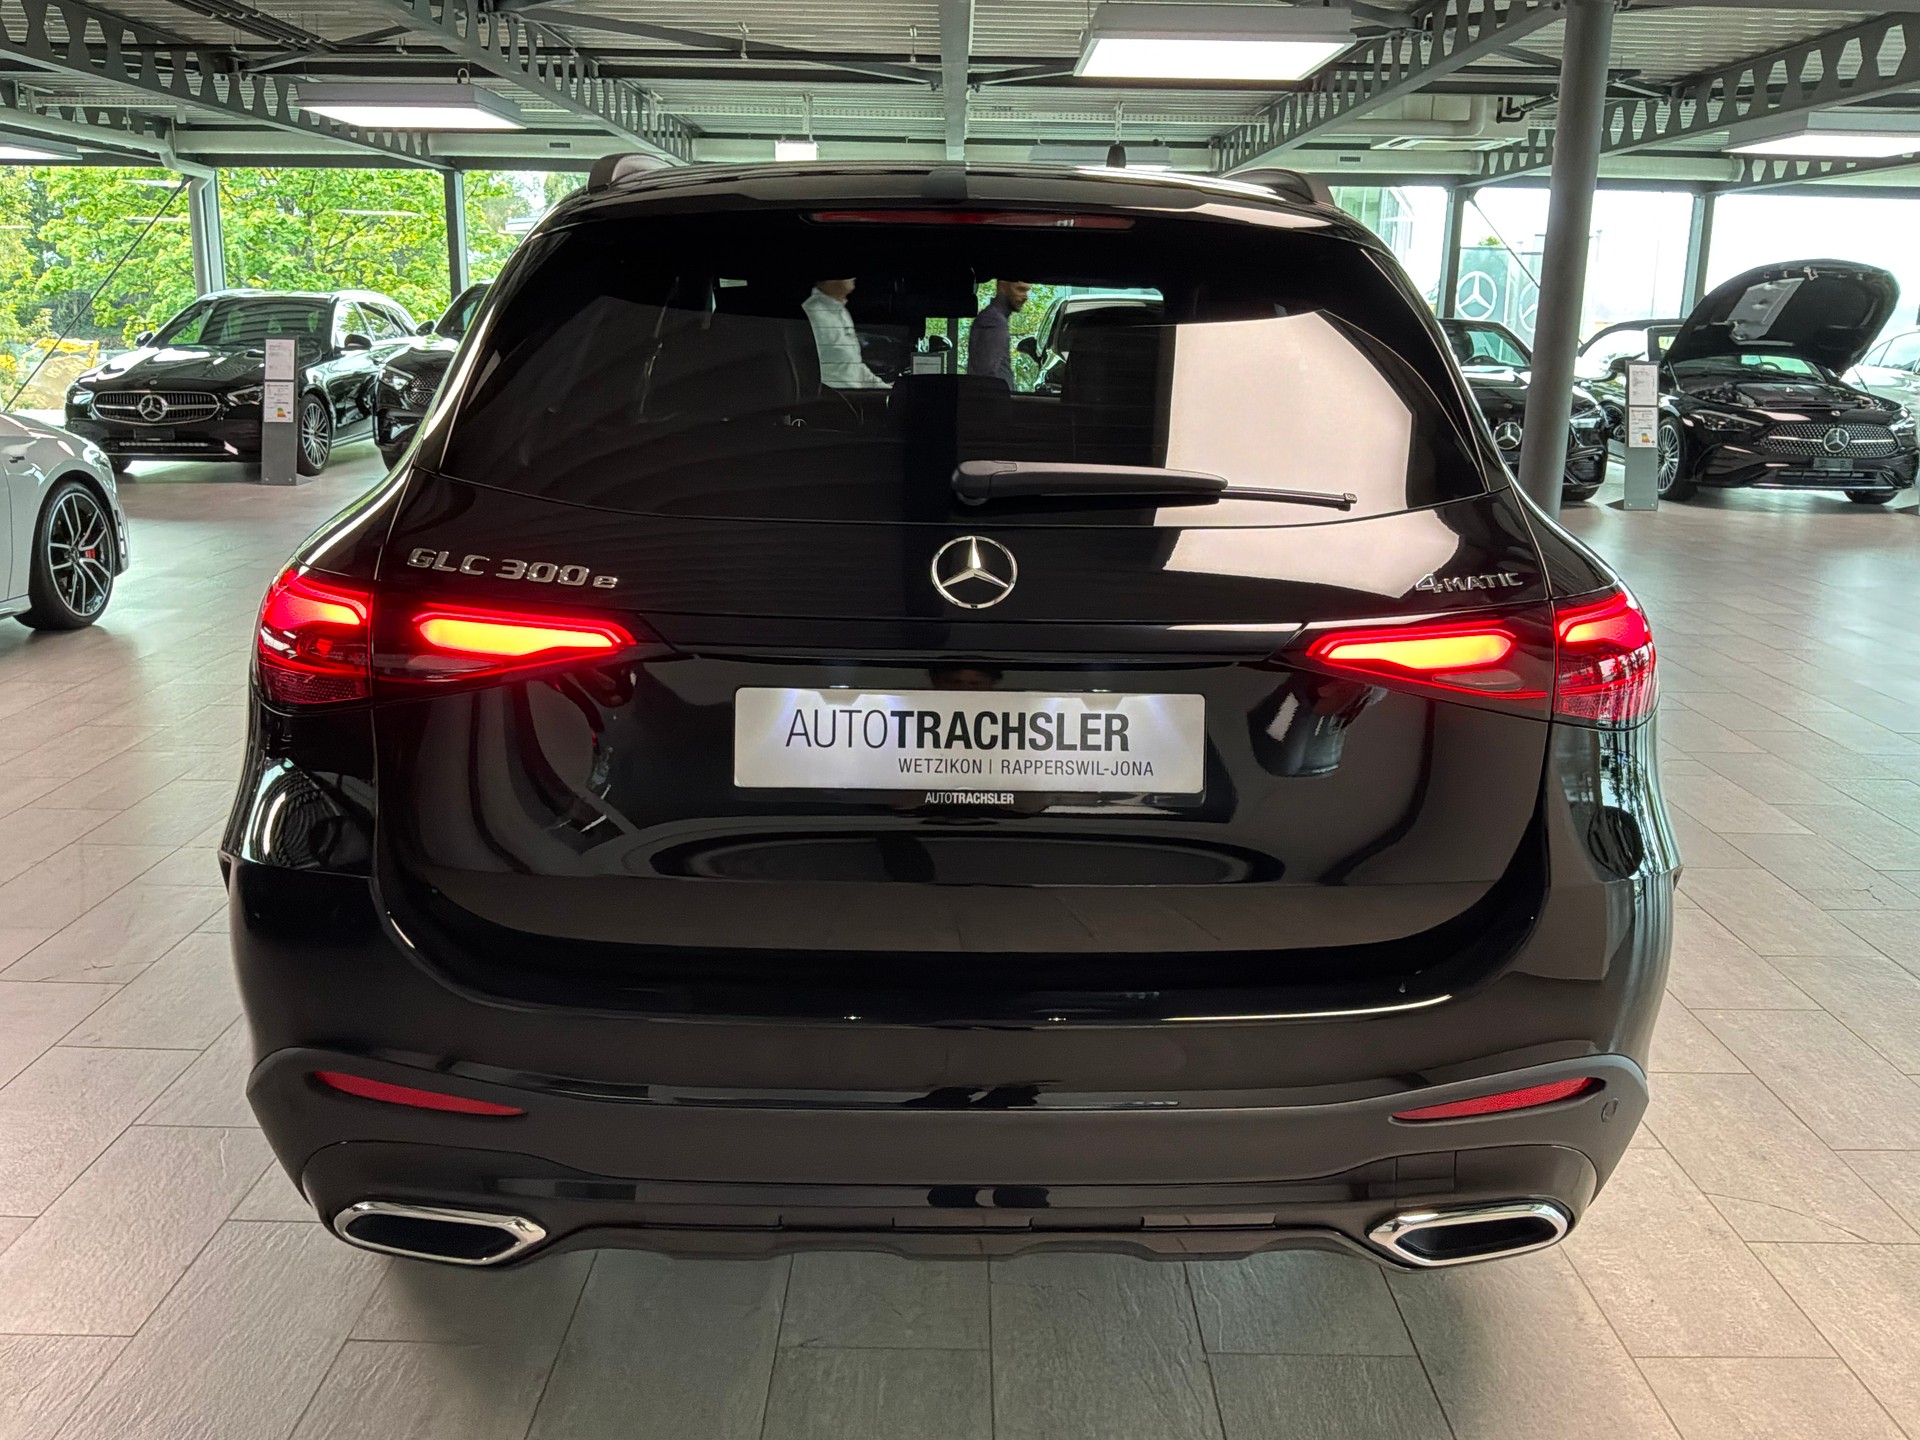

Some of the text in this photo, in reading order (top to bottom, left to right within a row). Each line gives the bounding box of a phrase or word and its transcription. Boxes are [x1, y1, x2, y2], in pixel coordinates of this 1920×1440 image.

[407, 547, 490, 576] GLC
[1415, 572, 1524, 594] 4MATIC
[785, 708, 1130, 752] AUTOTRACHSLER
[898, 757, 983, 775] WETZIKON
[1000, 759, 1154, 777] RAPPERSWIL-JONA
[924, 791, 1015, 805] AUTOTRACHSLER
